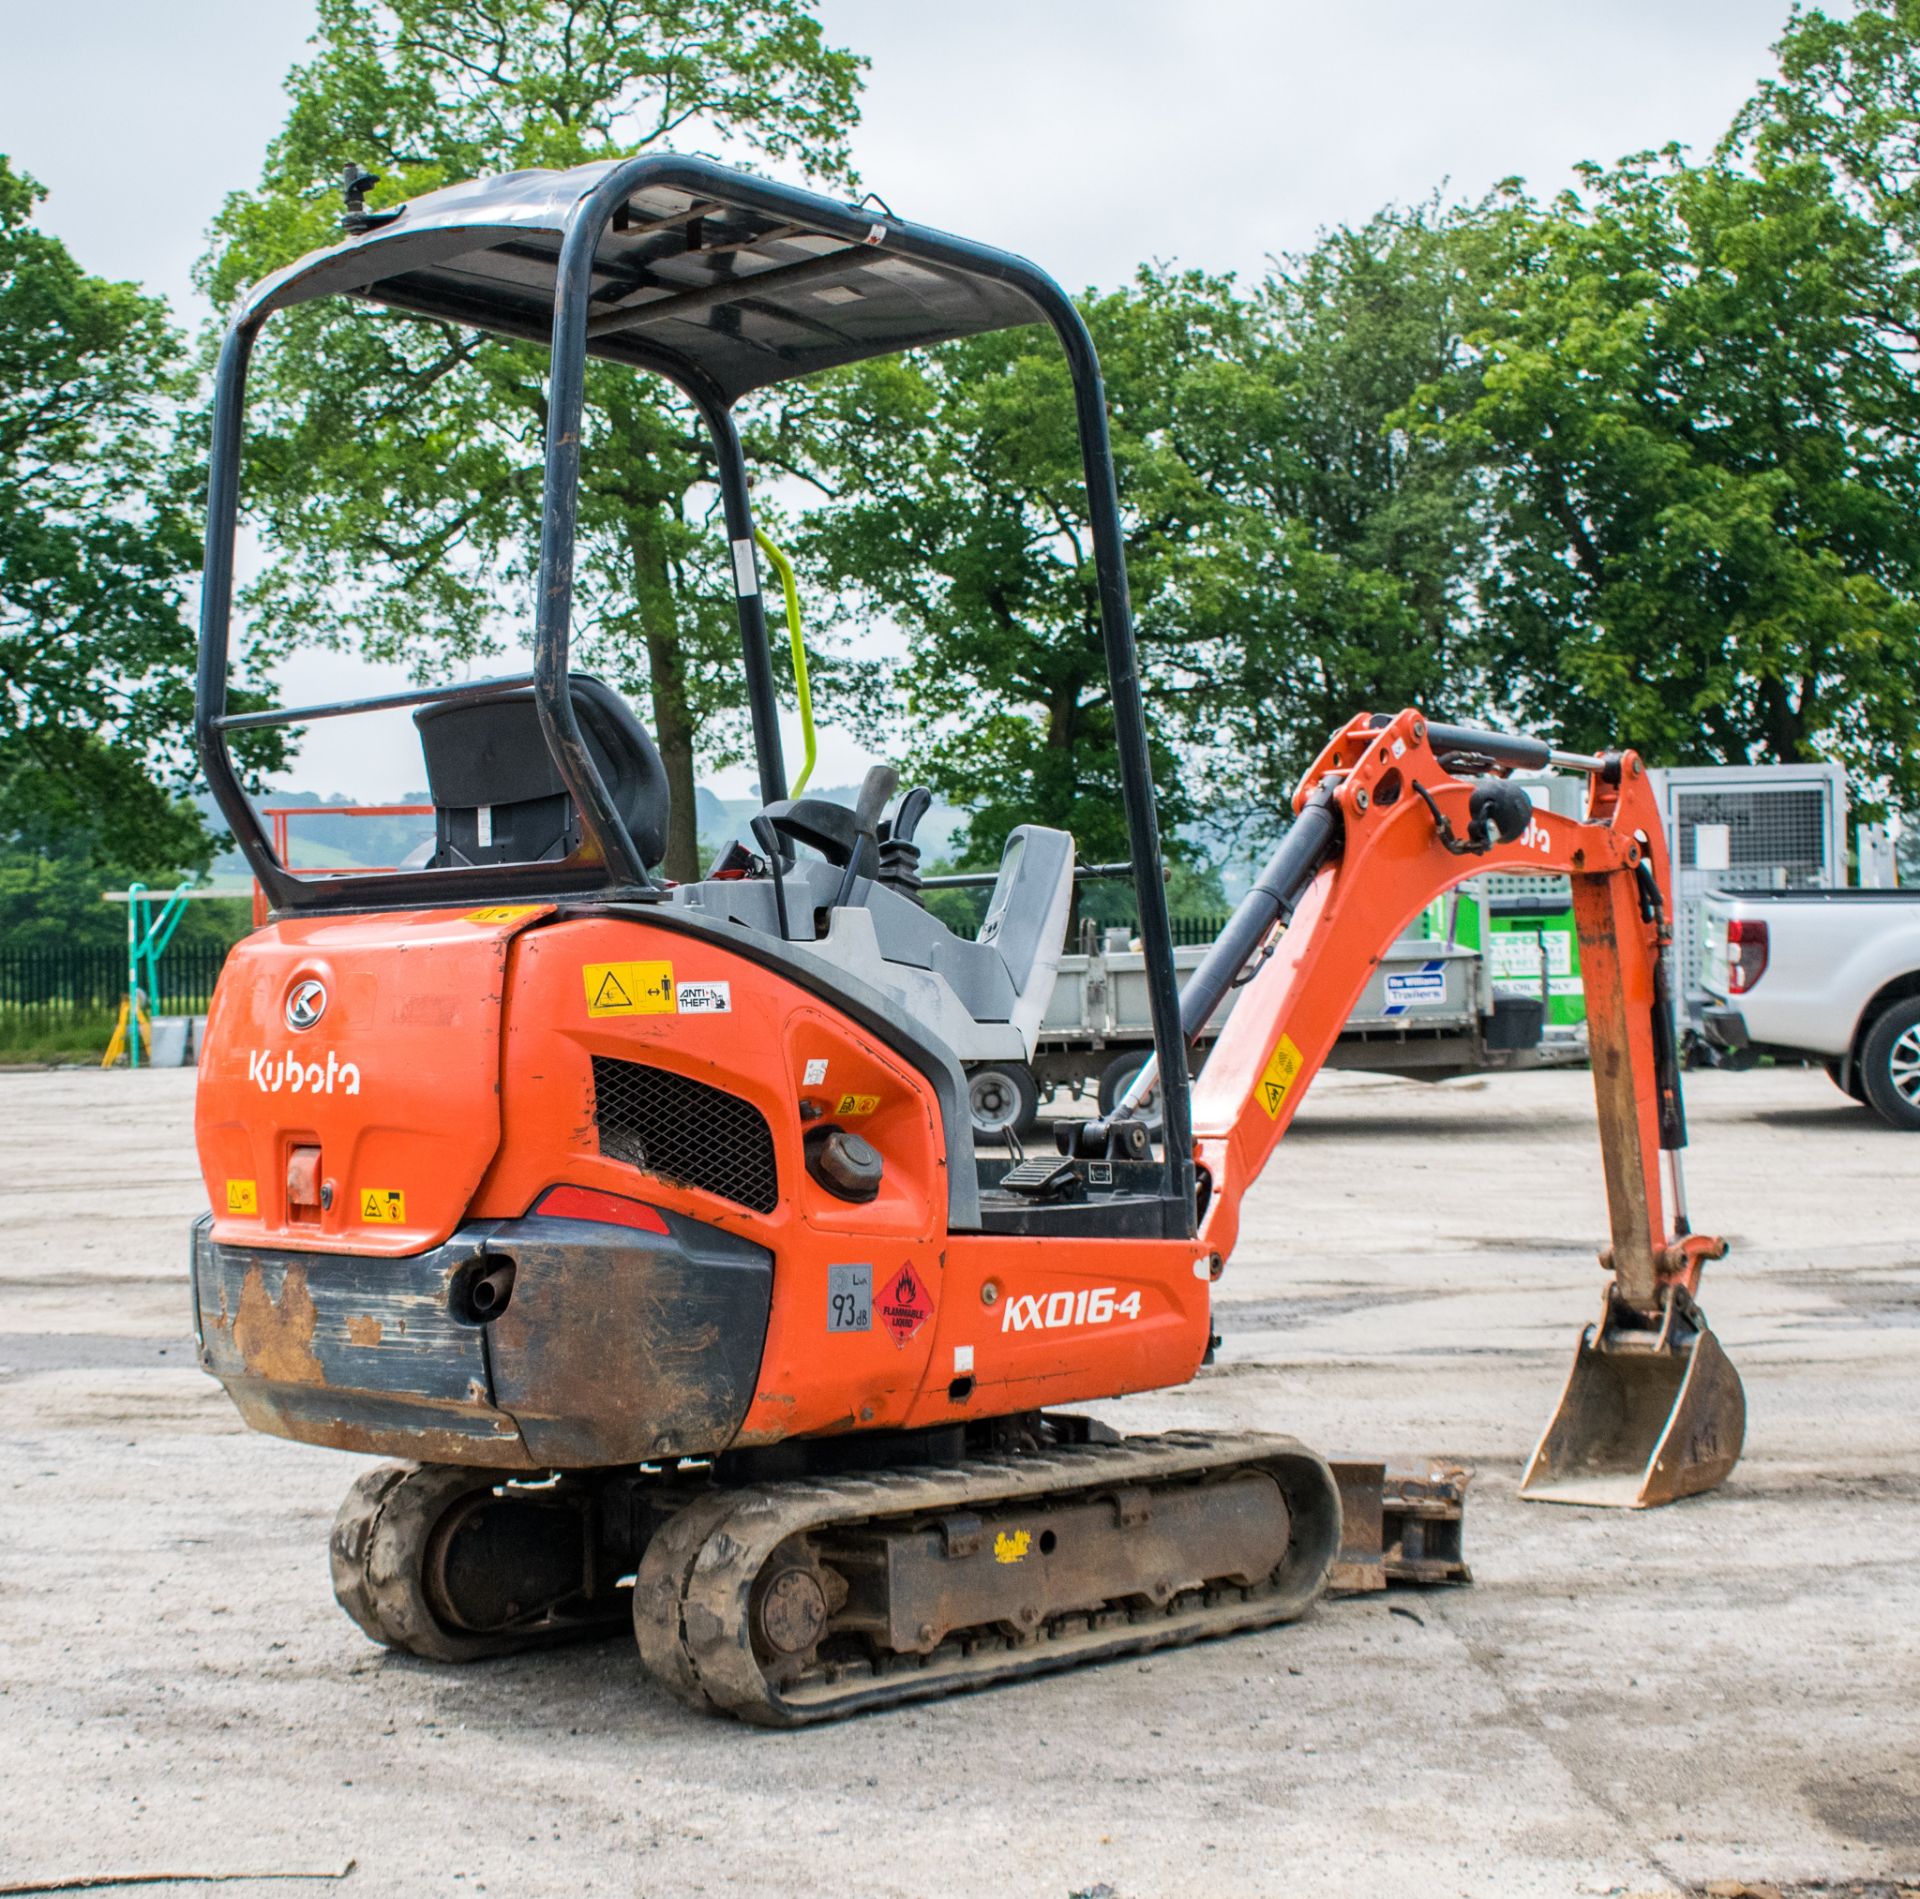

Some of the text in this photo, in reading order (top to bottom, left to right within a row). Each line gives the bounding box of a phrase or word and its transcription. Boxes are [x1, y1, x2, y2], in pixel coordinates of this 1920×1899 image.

[680, 989, 705, 998] ANTI
[1392, 991, 1441, 999] Trailers
[680, 998, 710, 1007] THEFT
[249, 1049, 360, 1095] Kubota
[832, 1294, 868, 1327] 93 dB
[883, 1306, 925, 1320] FLAMMABLE
[1001, 1287, 1142, 1333] KX016-4
[892, 1318, 914, 1328] LIQUID
